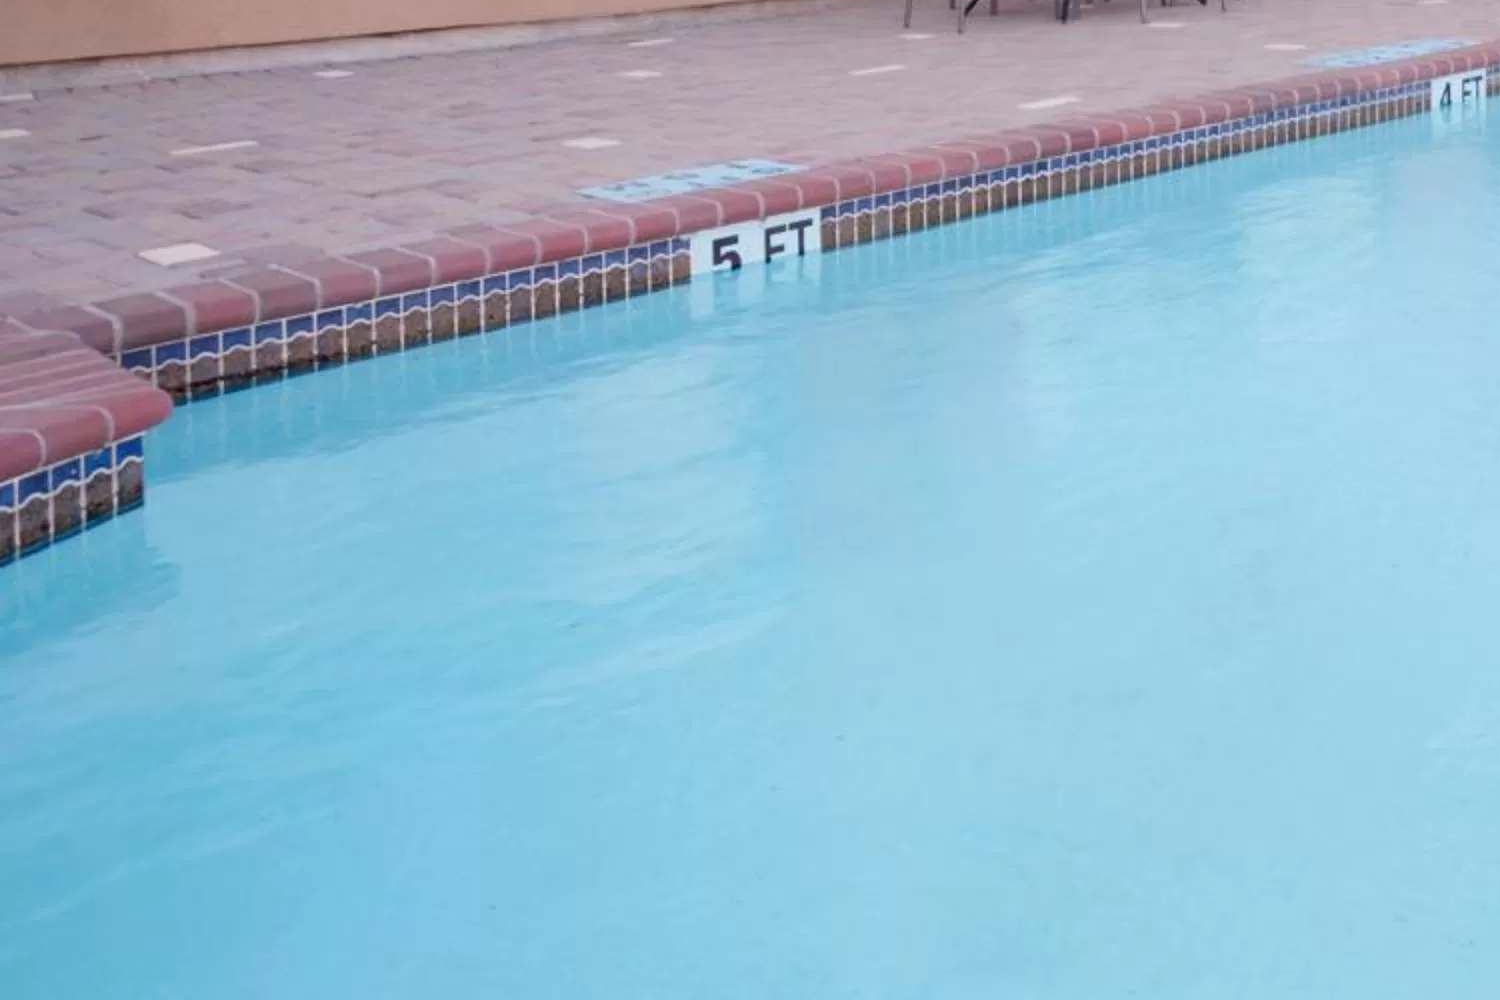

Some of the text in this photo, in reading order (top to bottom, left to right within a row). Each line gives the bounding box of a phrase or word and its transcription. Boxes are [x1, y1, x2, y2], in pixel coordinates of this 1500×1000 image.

[1440, 75, 1483, 106] 4 FT
[712, 218, 813, 270] 5 FT
